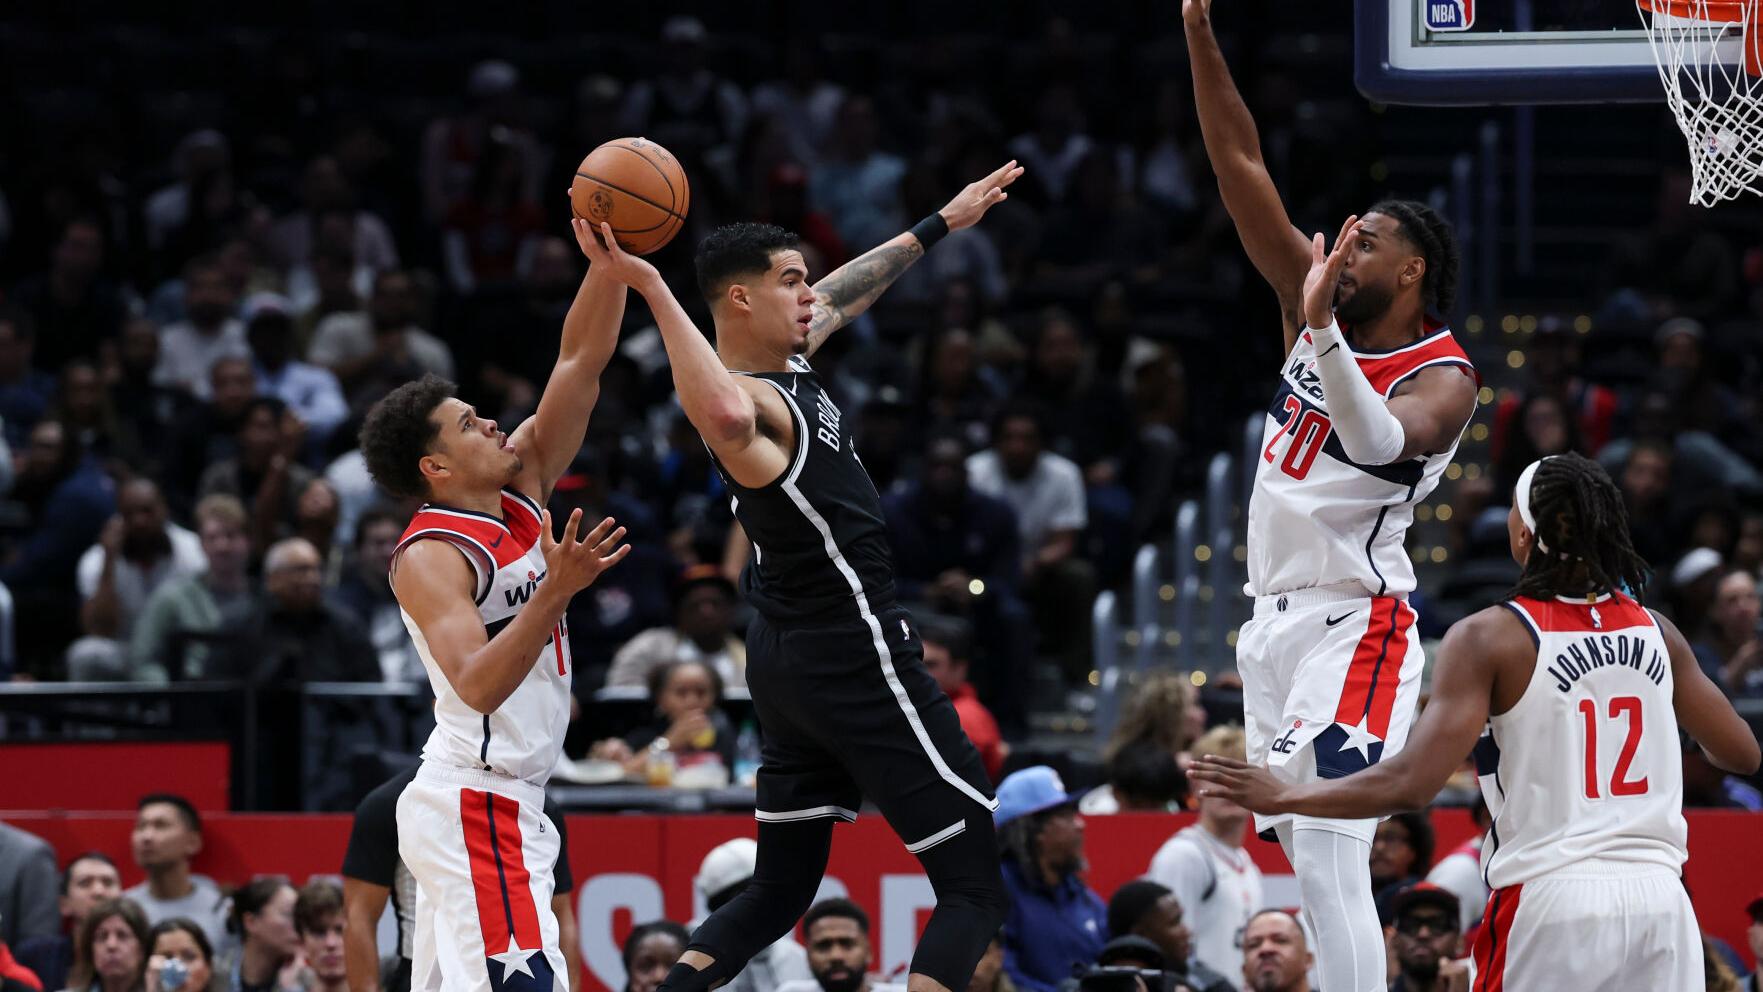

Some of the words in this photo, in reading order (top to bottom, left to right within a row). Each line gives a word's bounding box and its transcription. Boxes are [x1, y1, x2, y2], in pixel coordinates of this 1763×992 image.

[1431, 4, 1456, 23] NBA
[1263, 393, 1332, 481] 20
[1547, 635, 1645, 693] JOHNSON
[1645, 648, 1666, 686] III
[1578, 695, 1649, 799] 12
